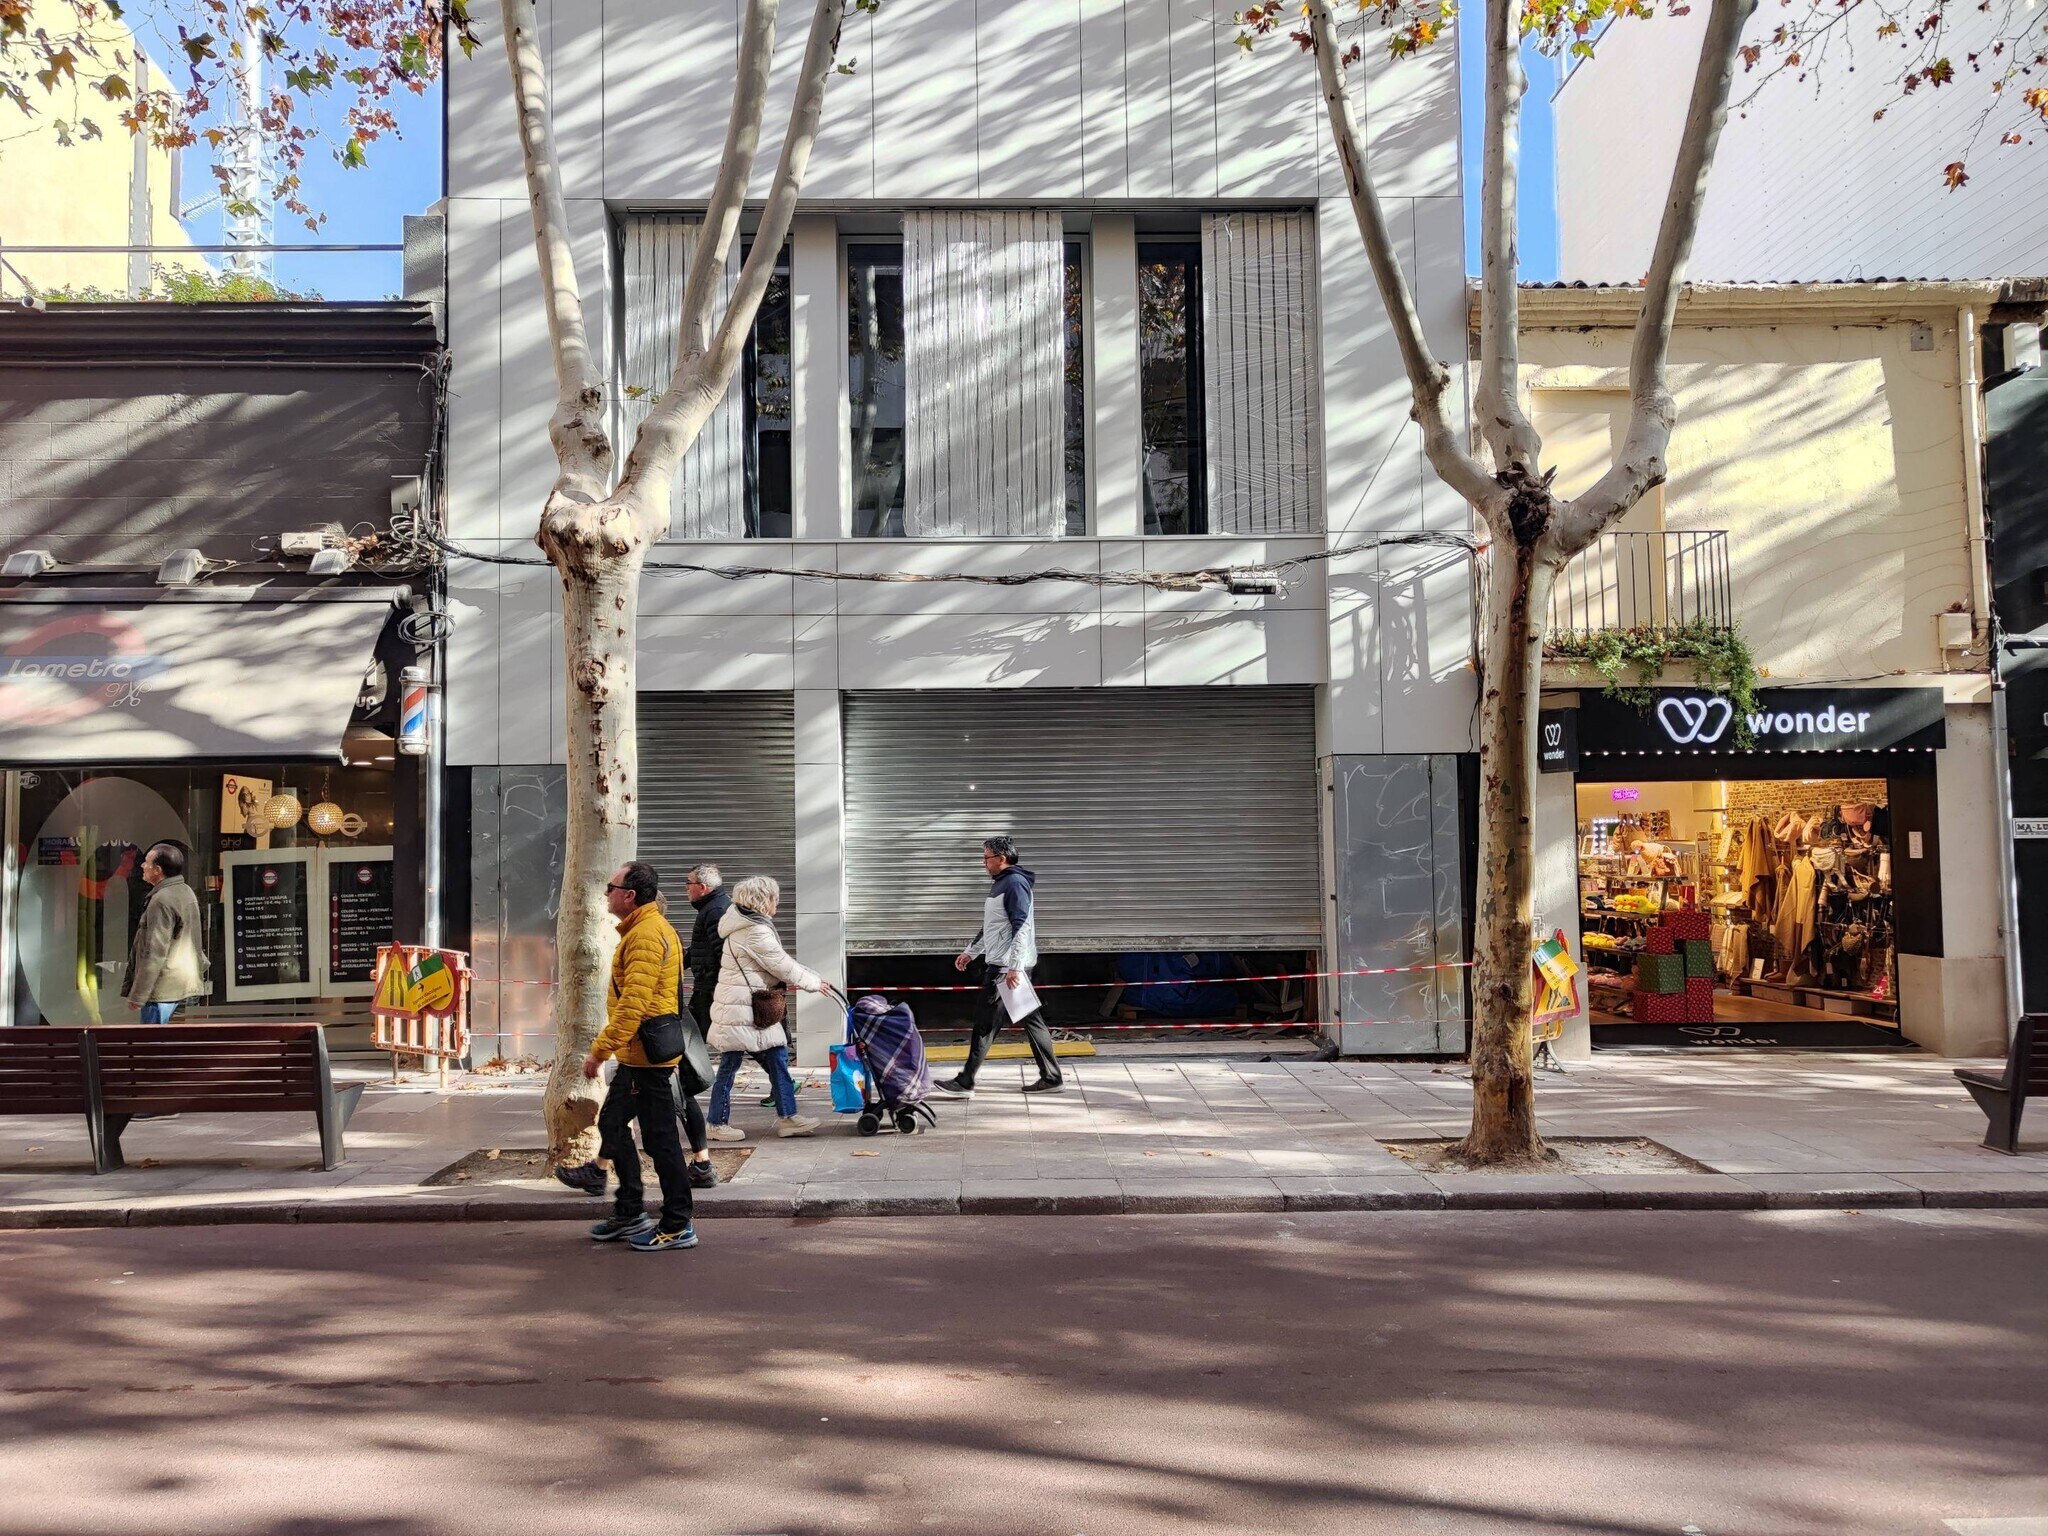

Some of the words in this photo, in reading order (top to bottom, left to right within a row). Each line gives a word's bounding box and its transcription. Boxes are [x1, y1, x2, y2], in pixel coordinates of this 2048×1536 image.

[1747, 705, 1870, 734] wonder
[1544, 748, 1564, 760] wonder
[220, 837, 242, 848] ghd
[1690, 1037, 1778, 1045] wonder
